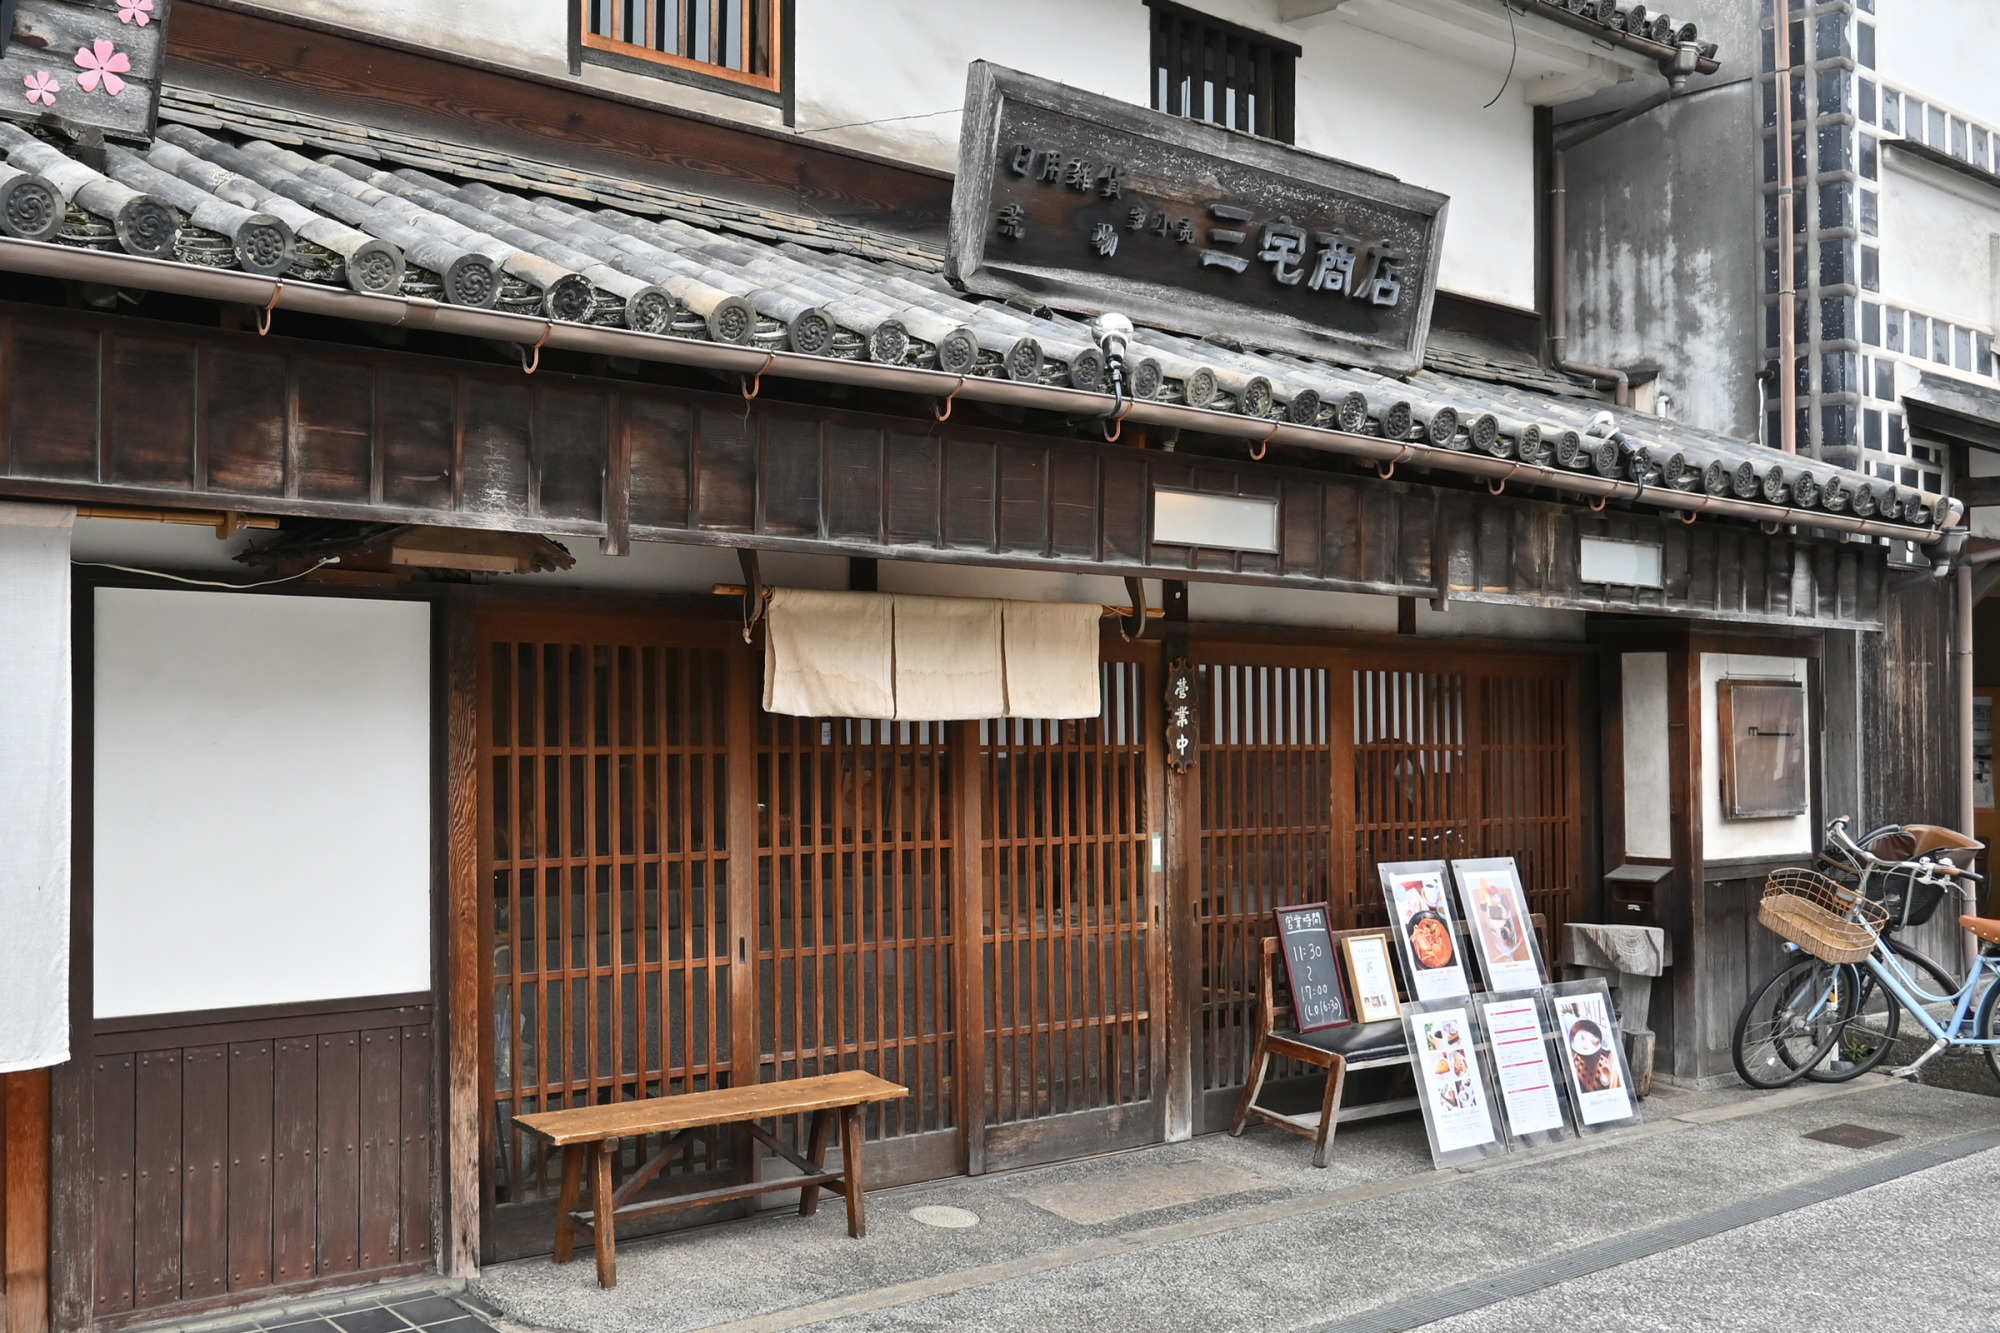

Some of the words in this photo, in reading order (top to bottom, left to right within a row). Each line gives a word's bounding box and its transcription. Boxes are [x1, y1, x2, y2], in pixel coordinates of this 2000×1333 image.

[1200, 203, 1404, 306] 三宅商店
[1285, 911, 1321, 930] 営業時間
[1293, 943, 1322, 961] 11:30
[1301, 984, 1328, 1002] 17:00
